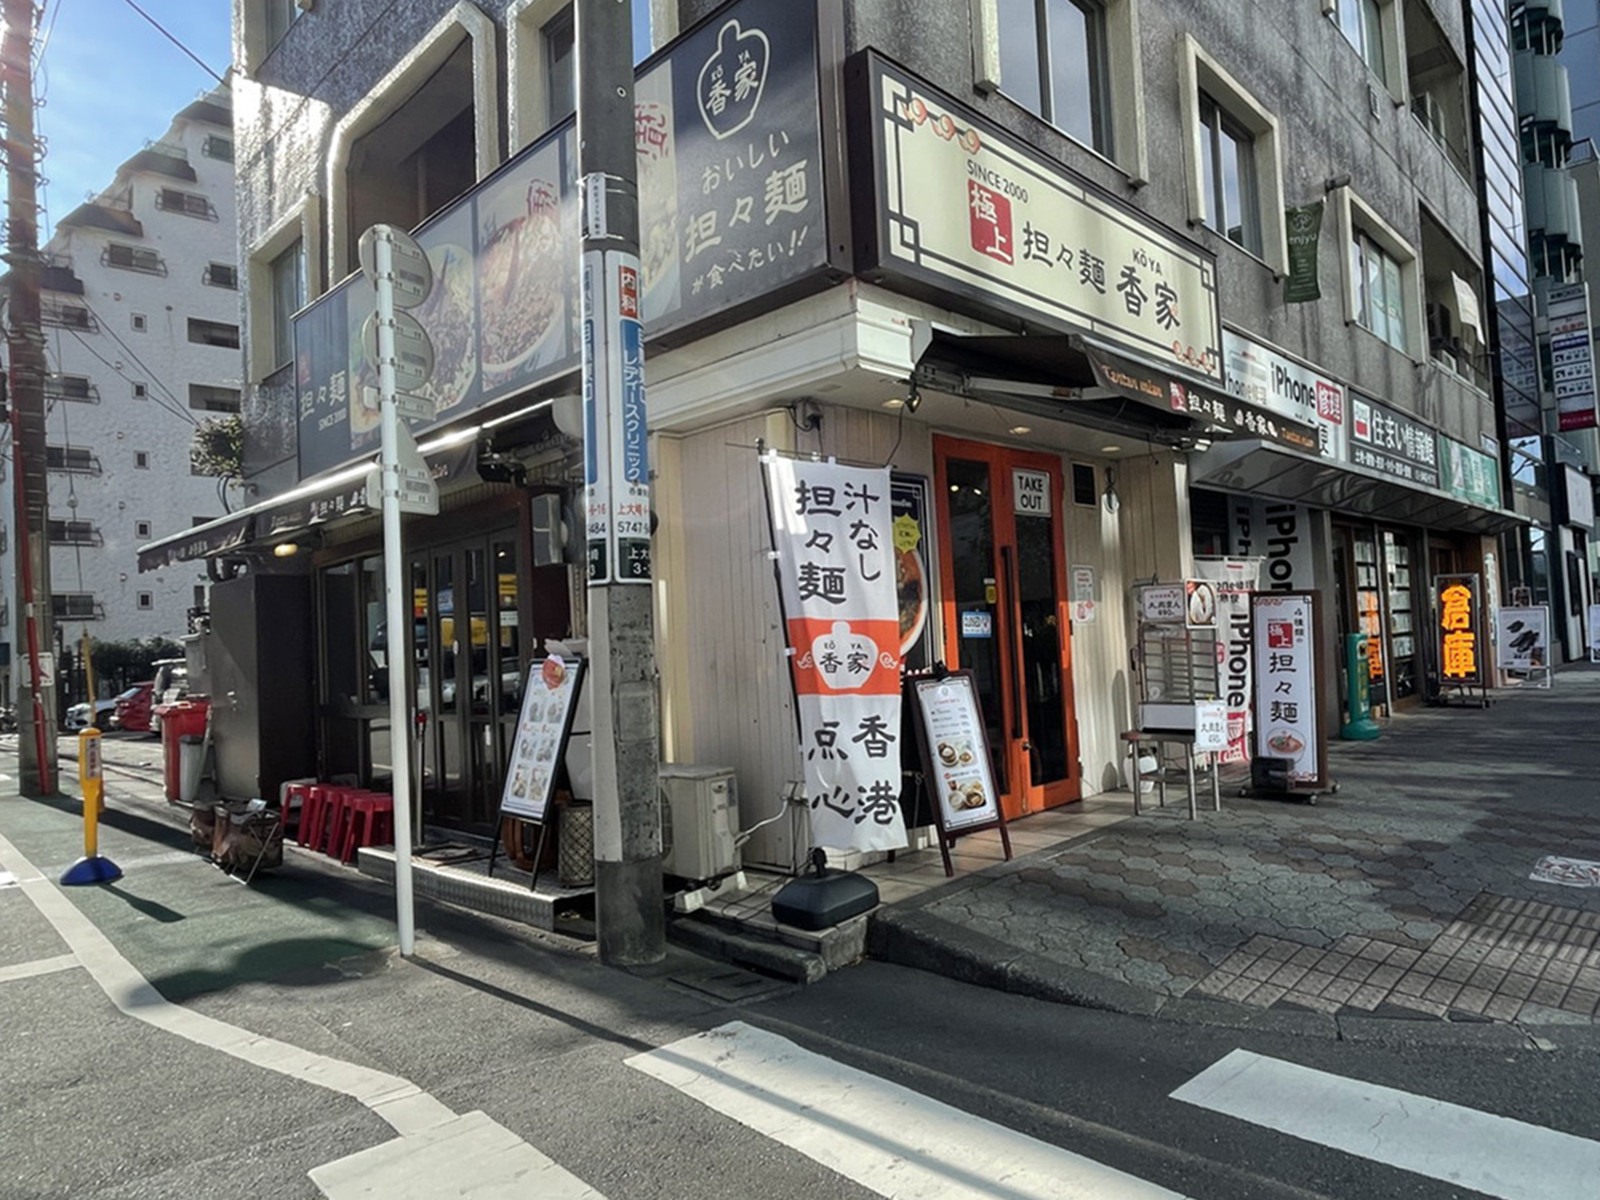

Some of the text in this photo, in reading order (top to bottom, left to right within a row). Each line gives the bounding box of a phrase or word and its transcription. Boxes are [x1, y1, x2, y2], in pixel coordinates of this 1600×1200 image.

[738, 50, 750, 63] YA
[706, 61, 759, 116] 香家
[702, 131, 789, 195] おいしい
[967, 159, 1029, 203] SINCE 2000
[685, 159, 808, 263] 担々麺
[970, 184, 1013, 265] 極上
[621, 272, 636, 316] 内科
[1022, 221, 1181, 330] 担々麺 香家
[300, 370, 345, 422] 担々麺
[1271, 362, 1316, 409] iPhone
[1017, 475, 1043, 493] TAKE
[1021, 496, 1043, 511] OUT
[794, 480, 847, 605] 担々麺
[843, 482, 881, 582] 汁なし
[850, 642, 863, 650] YA
[1269, 623, 1292, 647] 極上
[1441, 584, 1476, 679] 倉庫
[819, 652, 871, 674] 香家
[1269, 652, 1298, 724] 担々麺
[808, 722, 855, 819] 点心
[852, 715, 897, 825] 香港
